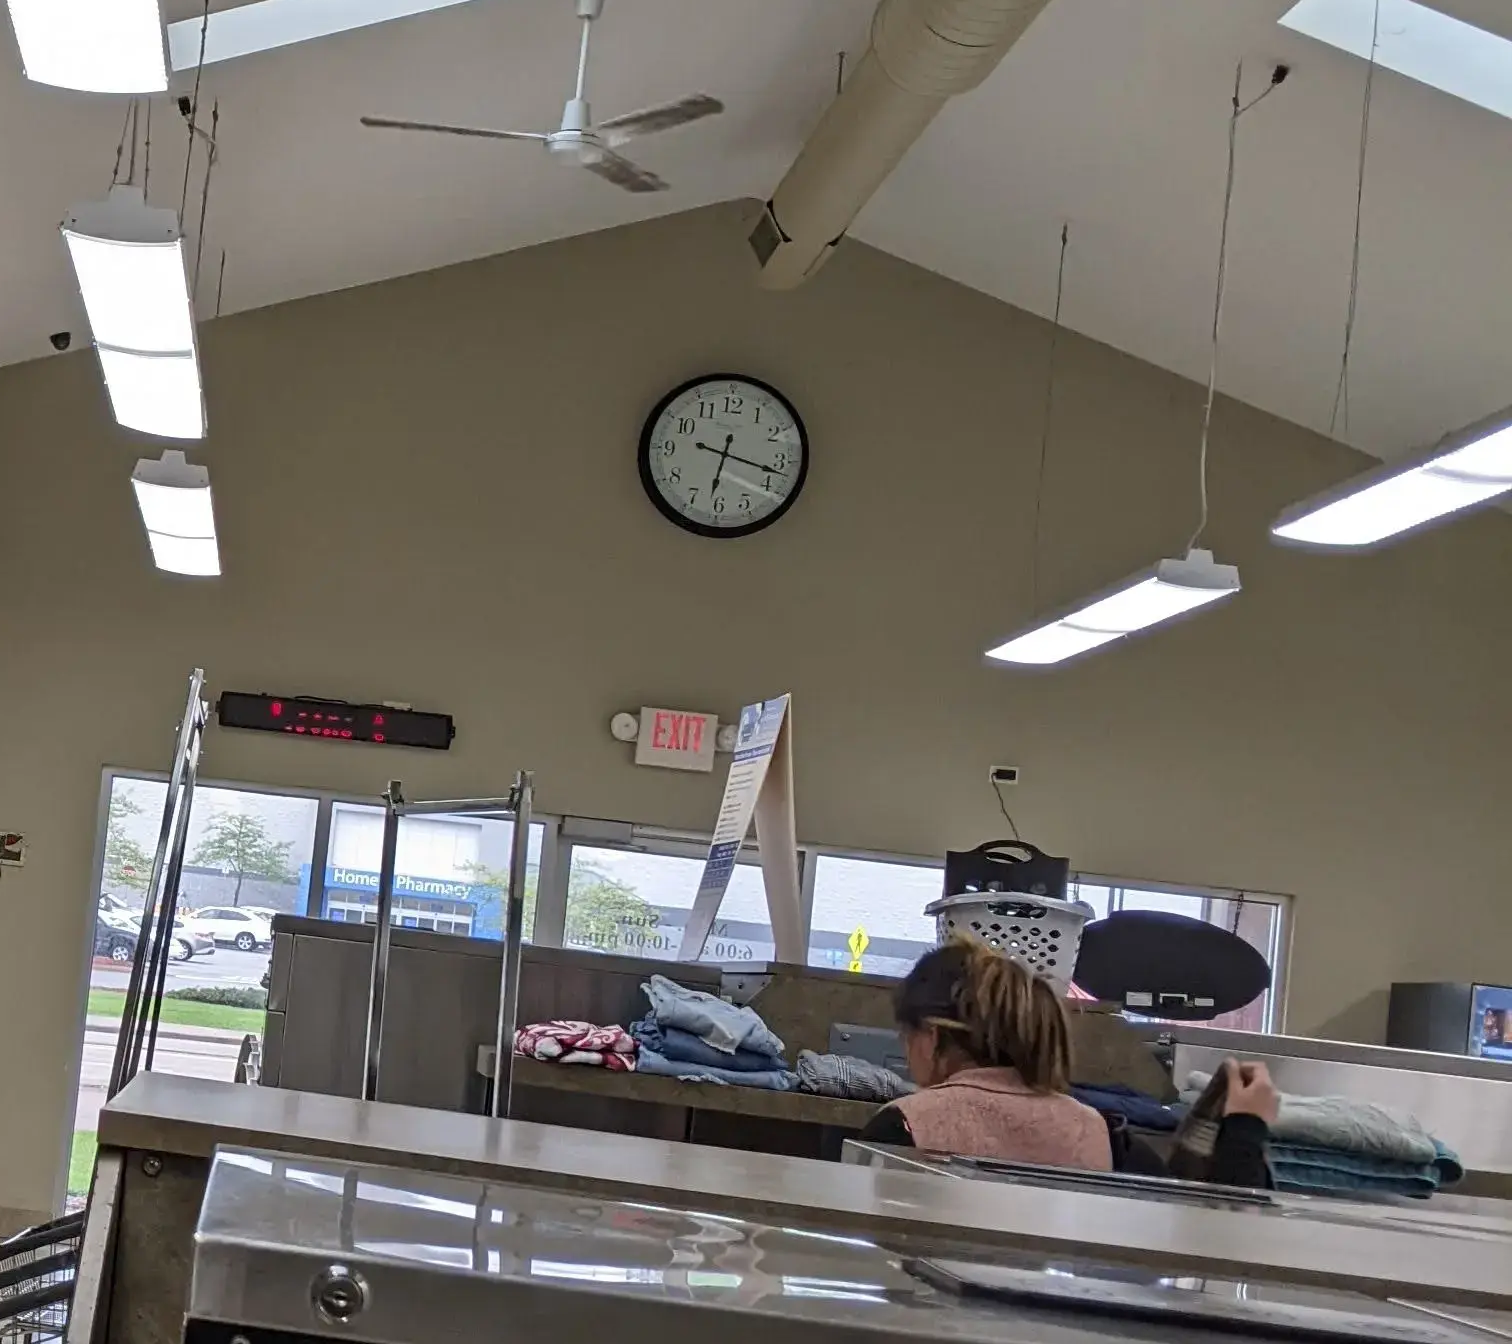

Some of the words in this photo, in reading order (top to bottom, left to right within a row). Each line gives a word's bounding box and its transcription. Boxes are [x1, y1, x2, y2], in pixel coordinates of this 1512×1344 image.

[699, 401, 716, 419] 11
[722, 396, 743, 414] 12
[754, 407, 760, 423] 1
[677, 417, 696, 436] 10
[768, 425, 780, 442] 2
[664, 440, 676, 456] 9
[773, 453, 785, 471] 3
[669, 467, 681, 484] 8
[760, 475, 772, 492] 4
[689, 487, 699, 505] 7
[713, 496, 725, 514] 6
[738, 493, 751, 511] 5
[652, 711, 706, 753] EXIT
[334, 868, 378, 887] Home
[396, 876, 472, 899] Pharmacy
